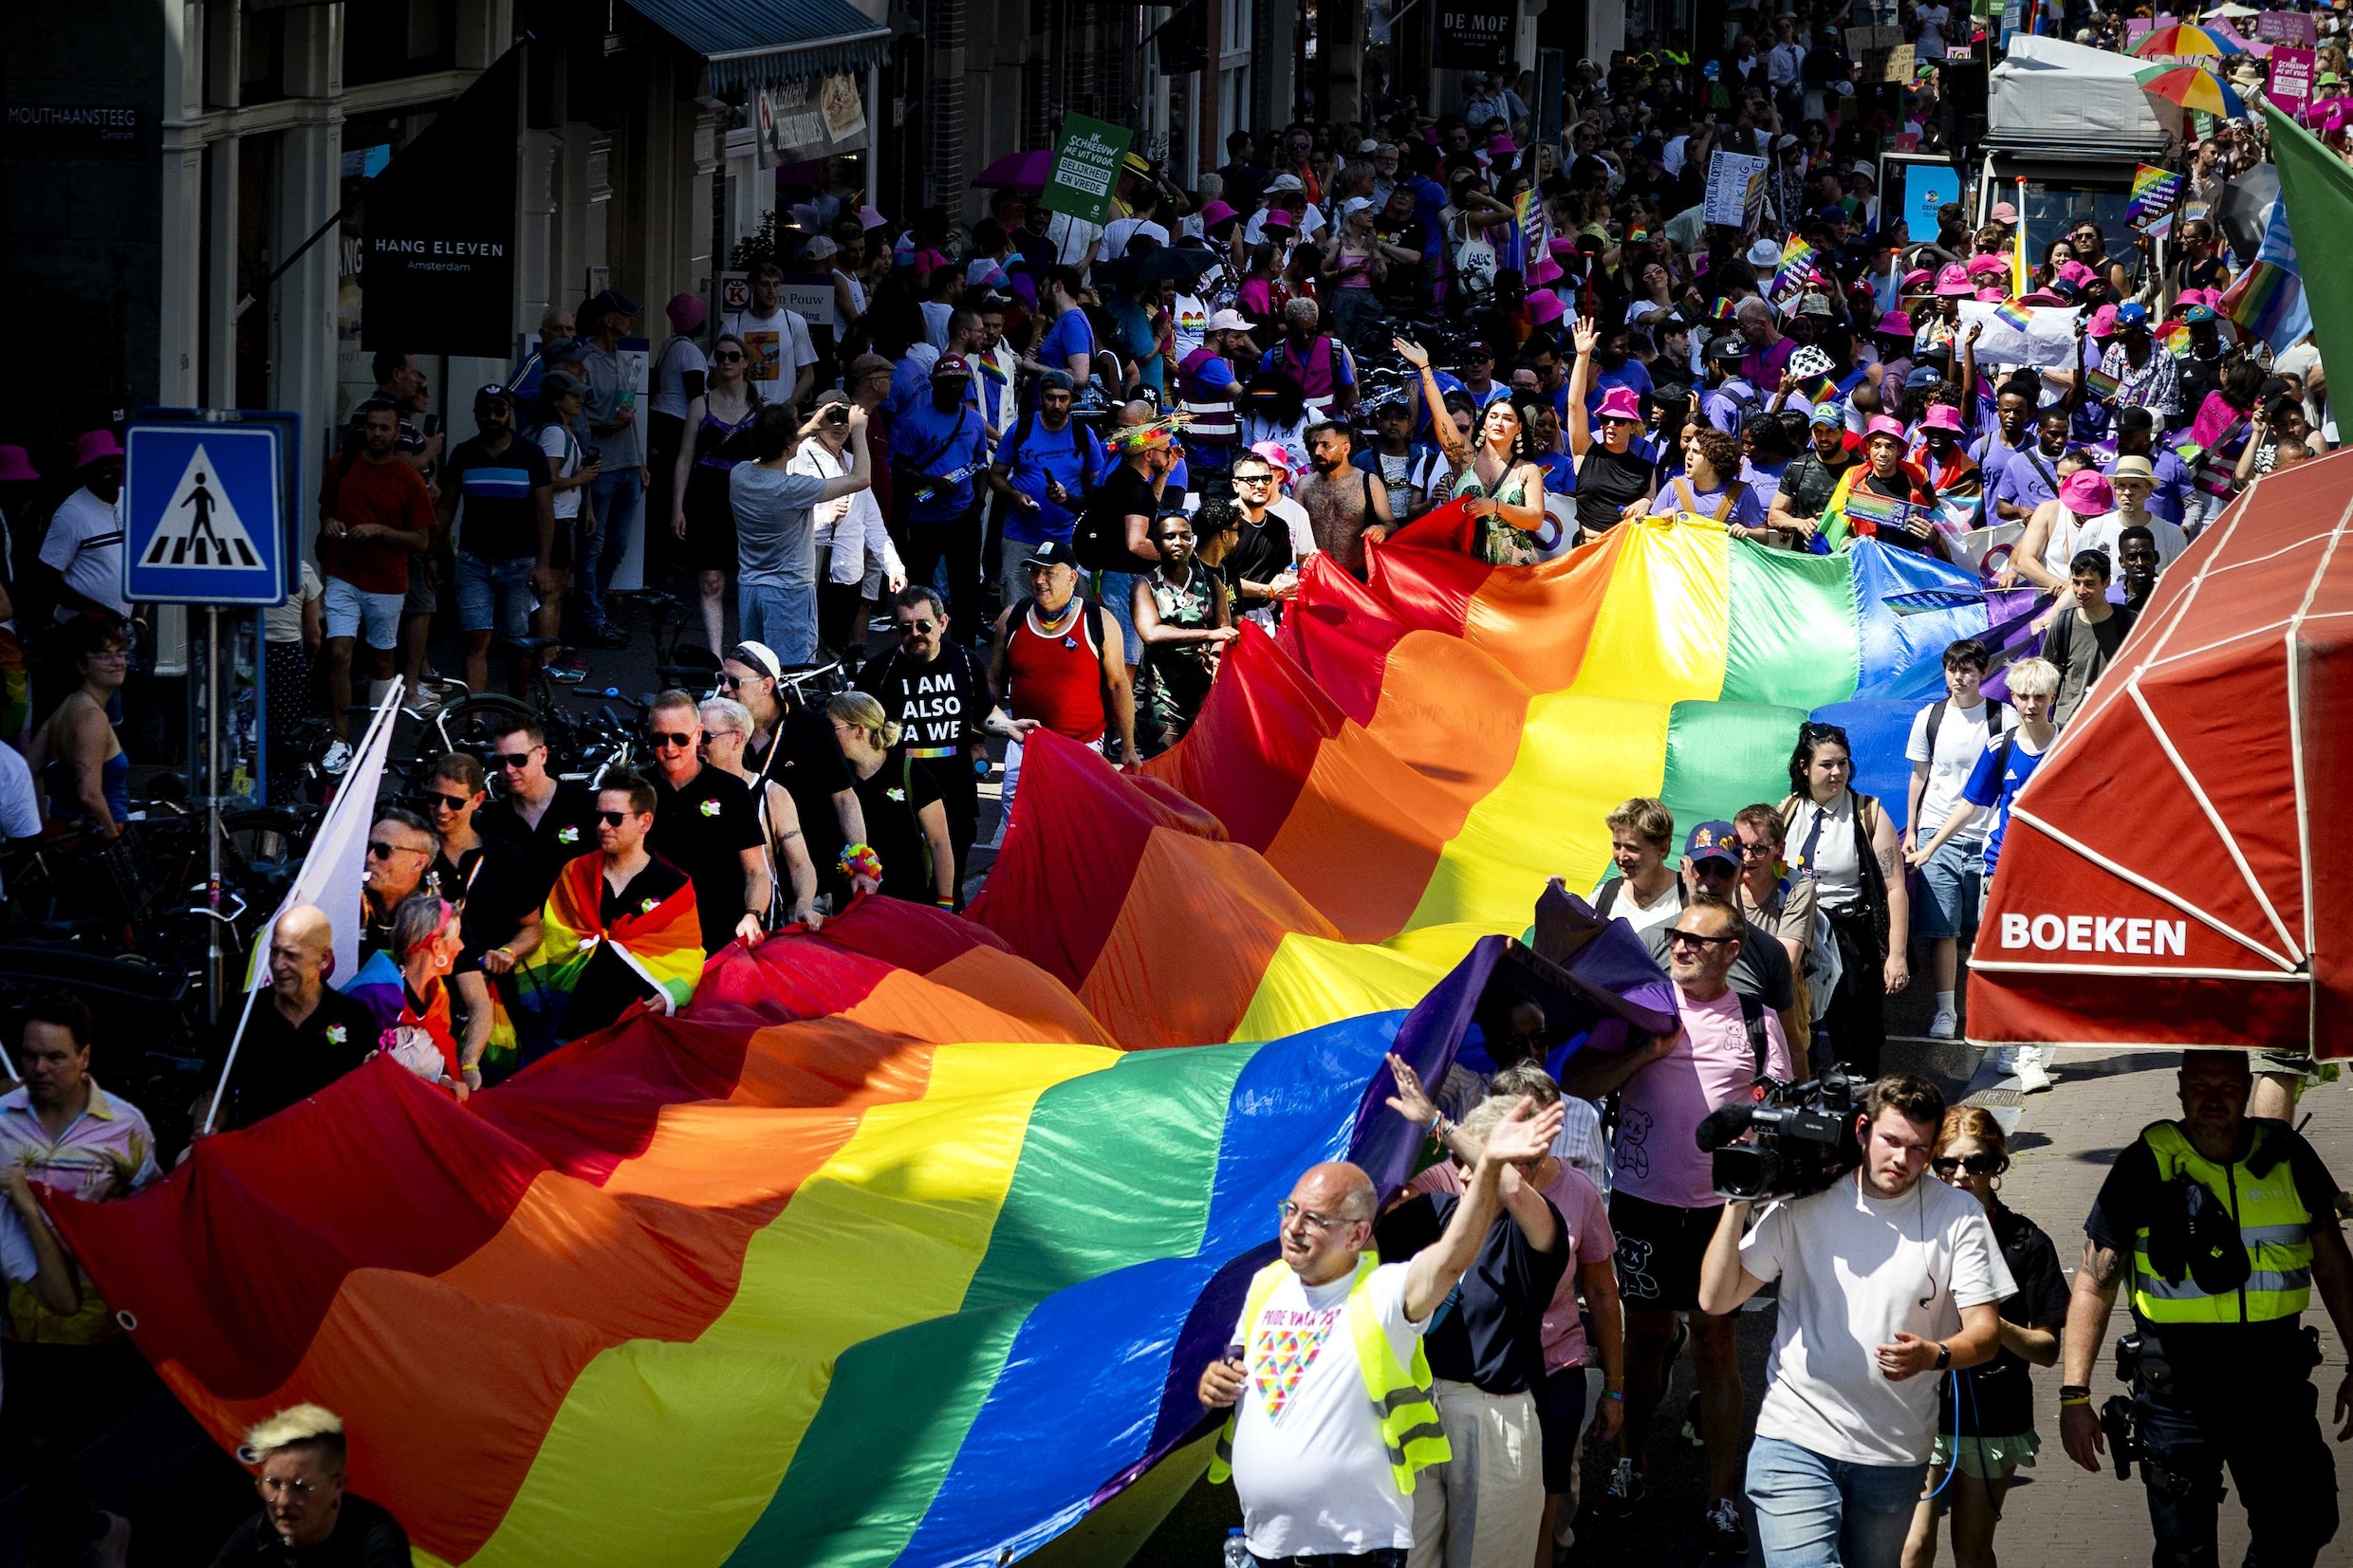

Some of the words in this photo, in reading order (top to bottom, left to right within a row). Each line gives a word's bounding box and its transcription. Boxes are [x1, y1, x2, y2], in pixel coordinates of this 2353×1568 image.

[1443, 12, 1465, 29] DE
[1472, 14, 1510, 32] MOF
[1452, 31, 1498, 41] AMSTERDAM
[8, 106, 136, 126] MOUTHAANSTEEG
[1068, 135, 1120, 157] SCHREEUW
[1090, 132, 1102, 143] IK
[1063, 145, 1077, 157] ME
[1061, 158, 1109, 181] GELIJKHEID
[1061, 174, 1072, 185] EN
[1074, 175, 1102, 194] VREDE
[2139, 197, 2168, 209] welcome
[375, 238, 426, 253] HANG
[434, 241, 504, 257] ELEVEN
[406, 260, 472, 272] Amsterdam
[790, 293, 824, 304] Pouw
[901, 678, 910, 695] I
[917, 673, 955, 695] AM
[901, 696, 961, 720] ALSO
[903, 724, 919, 742] A
[926, 720, 962, 742] WE
[2001, 913, 2187, 956] BOEKEN
